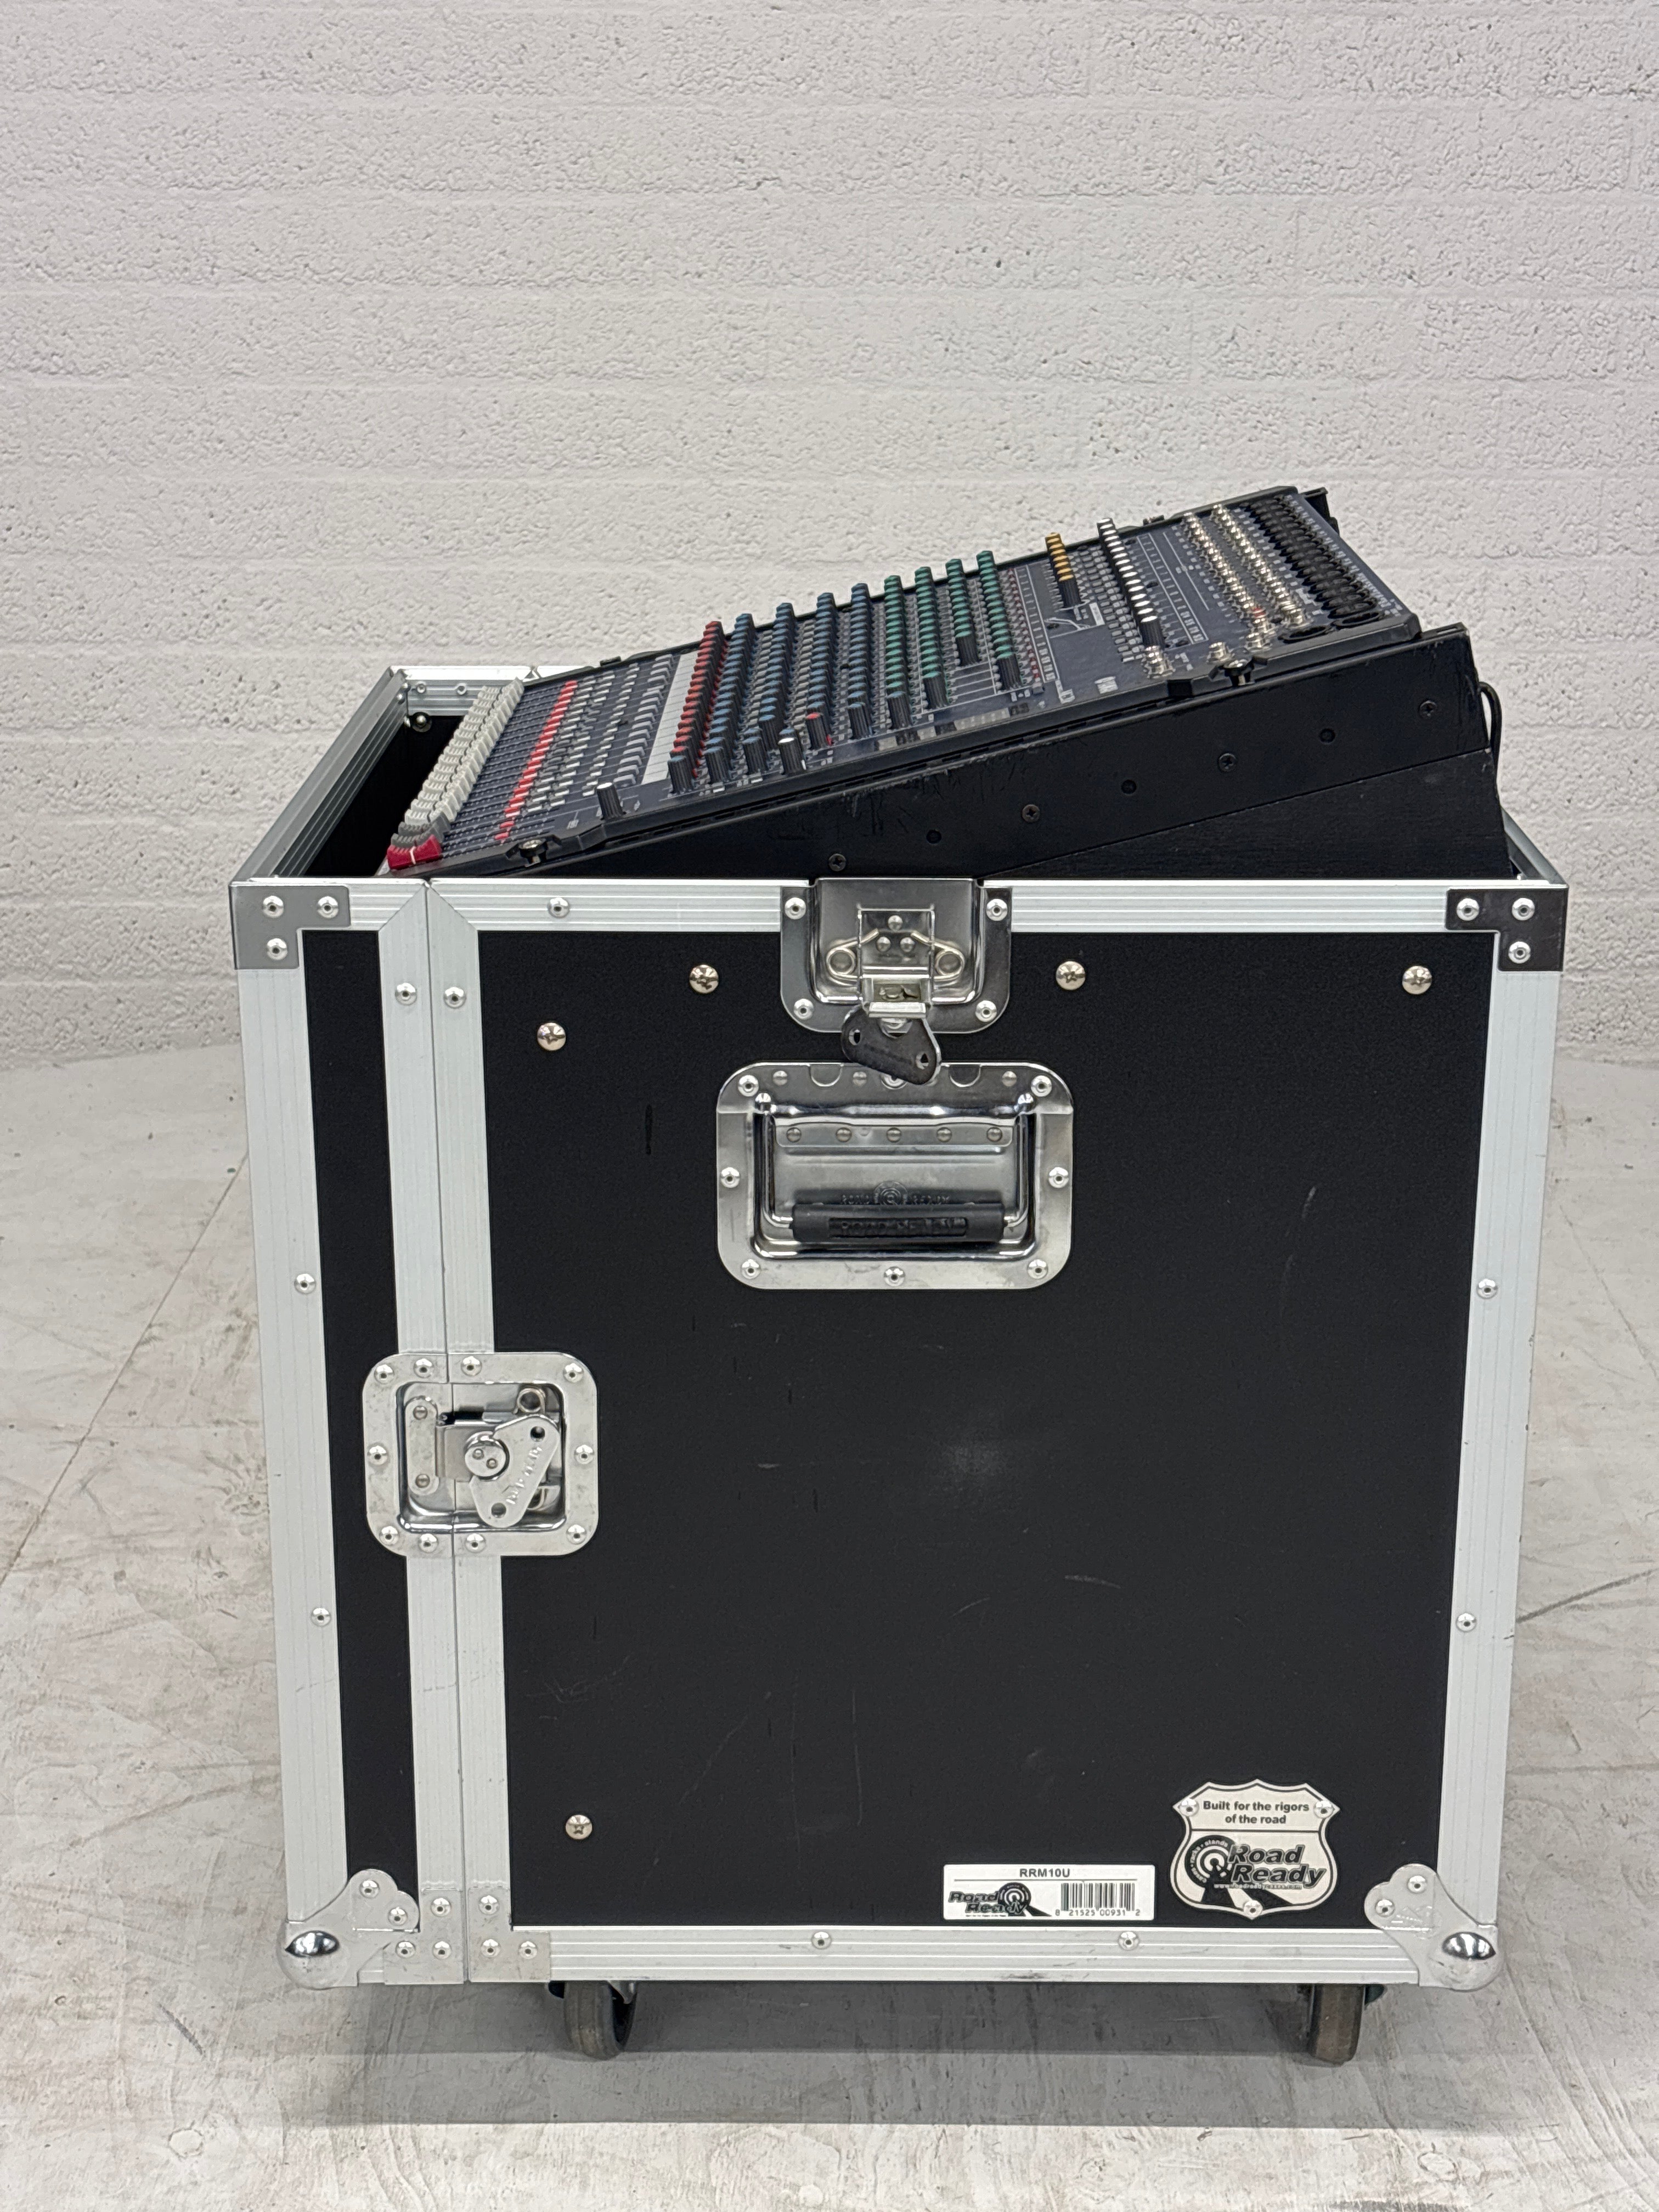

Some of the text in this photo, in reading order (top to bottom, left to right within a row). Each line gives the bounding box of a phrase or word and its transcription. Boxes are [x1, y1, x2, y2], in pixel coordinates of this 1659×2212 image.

[1203, 1801, 1310, 1813] Built for the rigors
[1225, 1814, 1286, 1824] of the road
[1204, 1839, 1228, 1848] stands
[1227, 1844, 1305, 1865] Road
[1019, 1868, 1070, 1878] RRM10U
[1231, 1863, 1327, 1888] Ready
[948, 1891, 1001, 1903] Road
